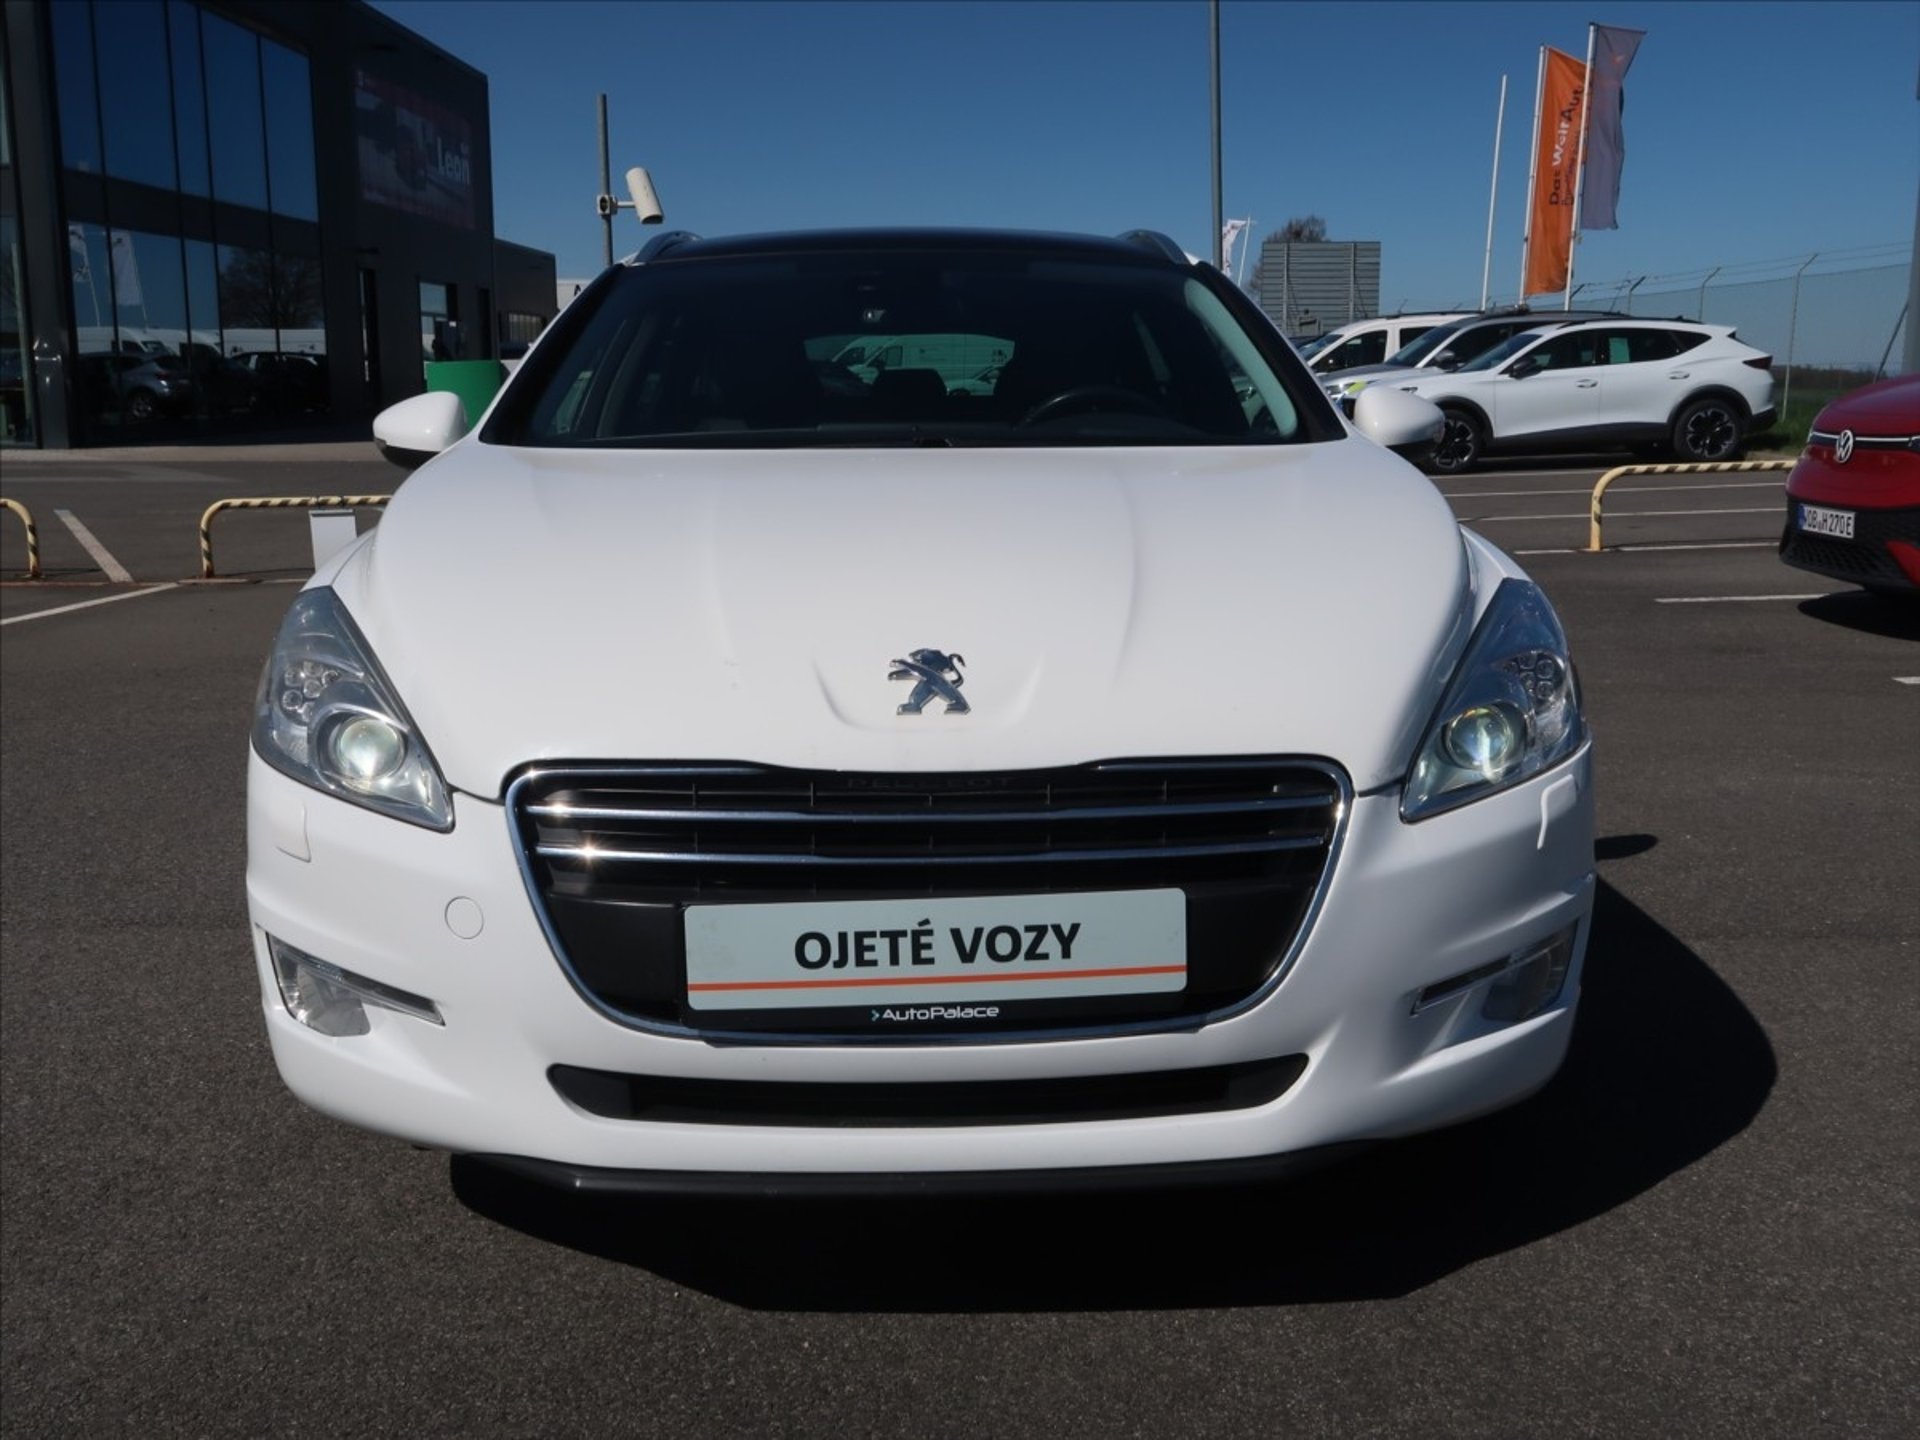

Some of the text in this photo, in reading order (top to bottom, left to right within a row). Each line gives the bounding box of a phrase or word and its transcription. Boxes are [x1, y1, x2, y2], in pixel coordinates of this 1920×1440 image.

[794, 918, 1081, 969] OJETÉ VOZY
[882, 1006, 999, 1021] AutoPalace
